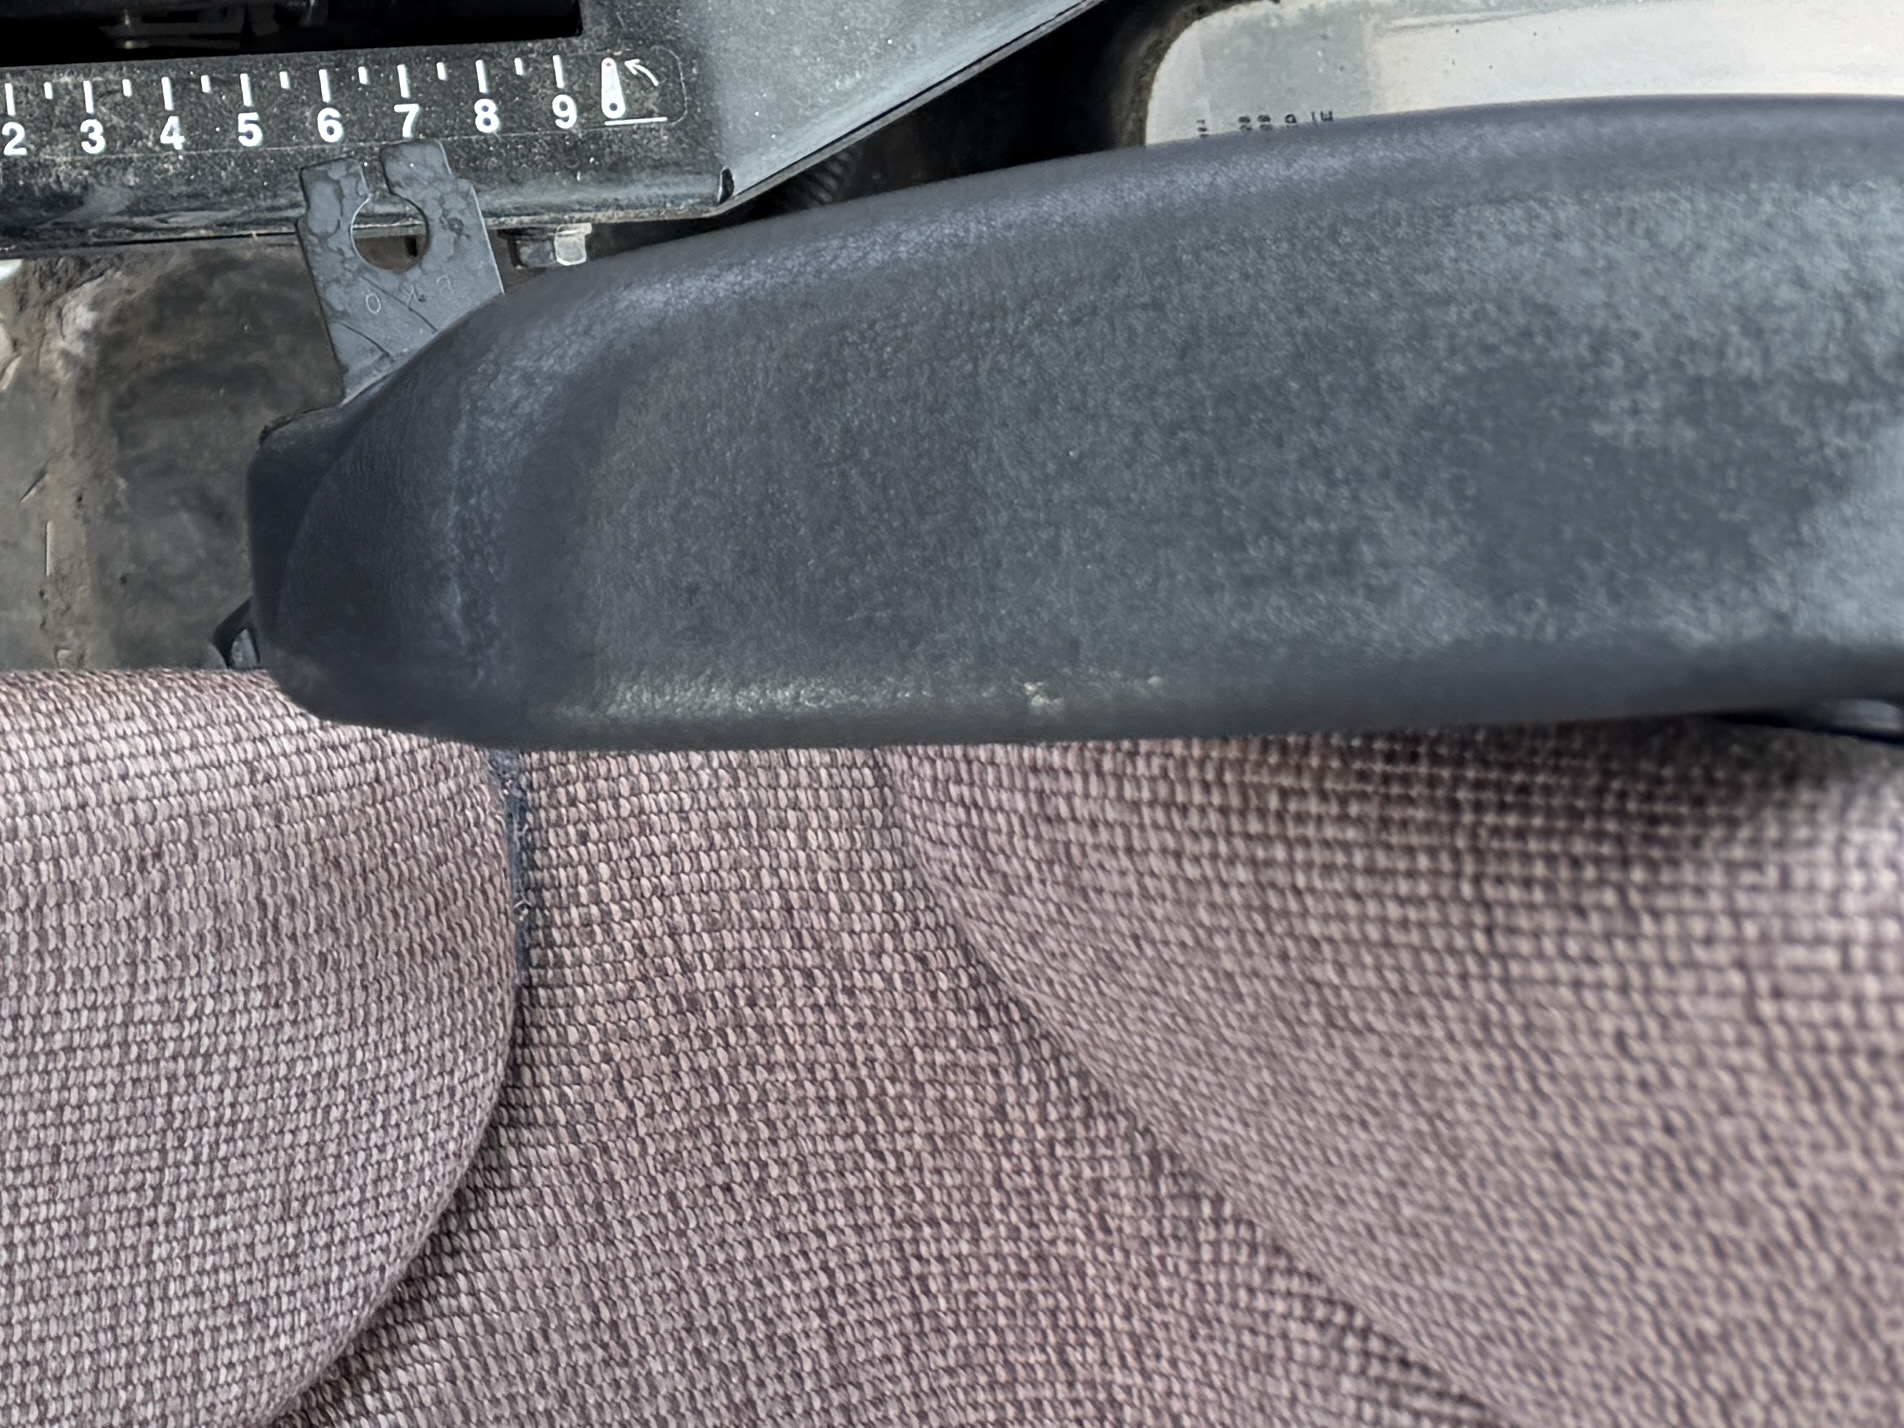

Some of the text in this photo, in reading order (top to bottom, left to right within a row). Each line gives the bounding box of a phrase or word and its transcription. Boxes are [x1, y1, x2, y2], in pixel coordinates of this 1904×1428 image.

[1, 121, 28, 157] 2
[79, 118, 107, 155] 3
[159, 115, 187, 151] 4
[237, 111, 264, 148] 5
[316, 107, 345, 144] 6
[393, 103, 421, 139] 7
[473, 98, 501, 137] 8
[551, 94, 578, 130] 9
